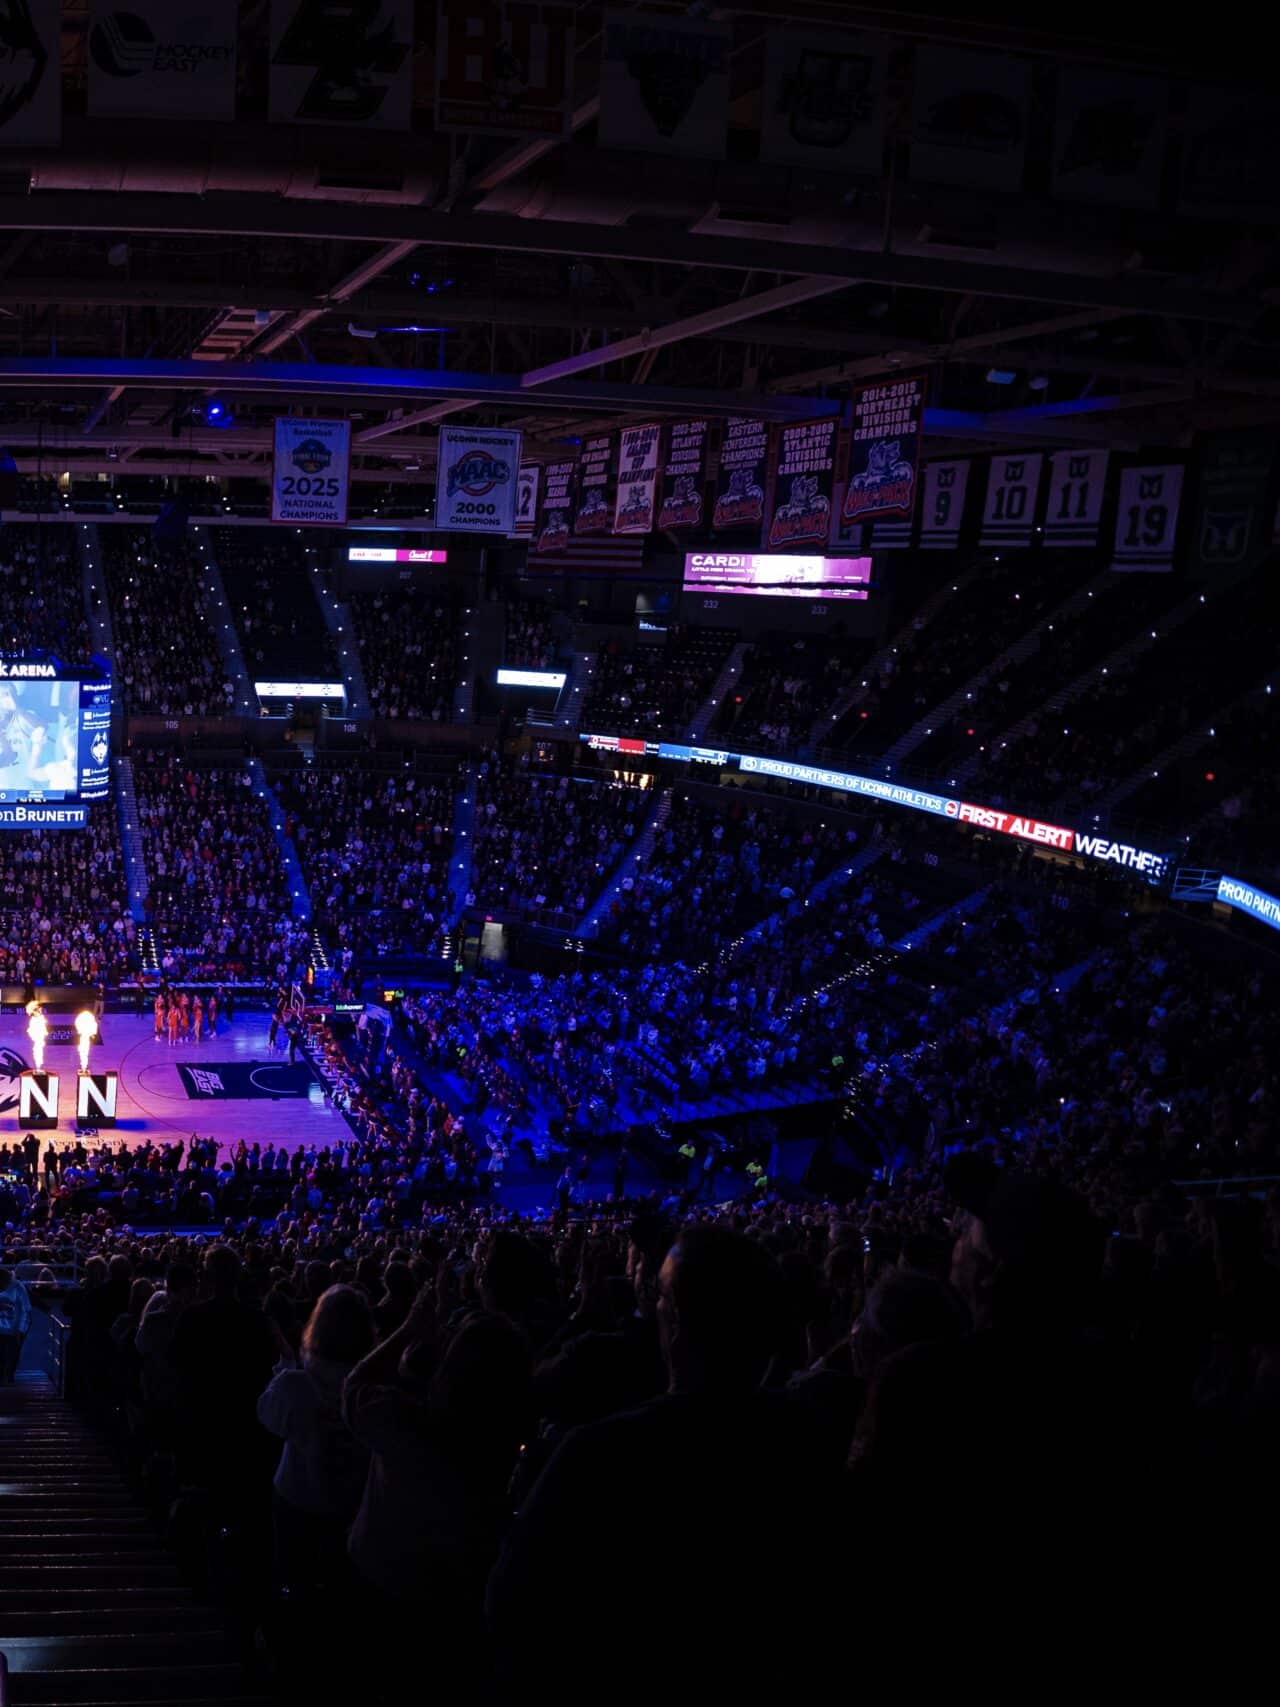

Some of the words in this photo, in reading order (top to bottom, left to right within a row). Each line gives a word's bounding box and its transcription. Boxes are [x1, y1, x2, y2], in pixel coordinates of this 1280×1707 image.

[157, 44, 235, 60] HOCKEY
[153, 57, 199, 72] EAST
[861, 382, 917, 403] 2014-2015
[854, 391, 921, 416] NORTHEAST
[861, 408, 910, 427] DIVISION
[728, 422, 764, 439] EASTERN
[853, 421, 918, 441] CHAMPIONS
[782, 434, 832, 453] ATLANTIC
[785, 446, 828, 464] DIVISION
[777, 457, 833, 476] CHAMPIONS
[282, 476, 339, 497] 2025
[447, 459, 511, 498] MAAC
[284, 499, 336, 510] NATIONAL
[455, 502, 496, 516] 2000
[935, 490, 951, 527] 9
[990, 485, 1028, 521] 10
[1054, 482, 1089, 518] 11
[279, 511, 339, 521] CHAMPIONS
[449, 516, 502, 526] CHAMPIONS
[1123, 504, 1169, 547] 19
[690, 554, 746, 568] CARDI
[9, 664, 57, 677] ARENA
[792, 766, 846, 787] PARTNERS
[860, 781, 892, 798] UCONN
[891, 787, 942, 810] ATHLETICS
[958, 802, 1009, 832] FIRST
[1008, 817, 1073, 849] ALERT
[1218, 879, 1253, 907] PROUD
